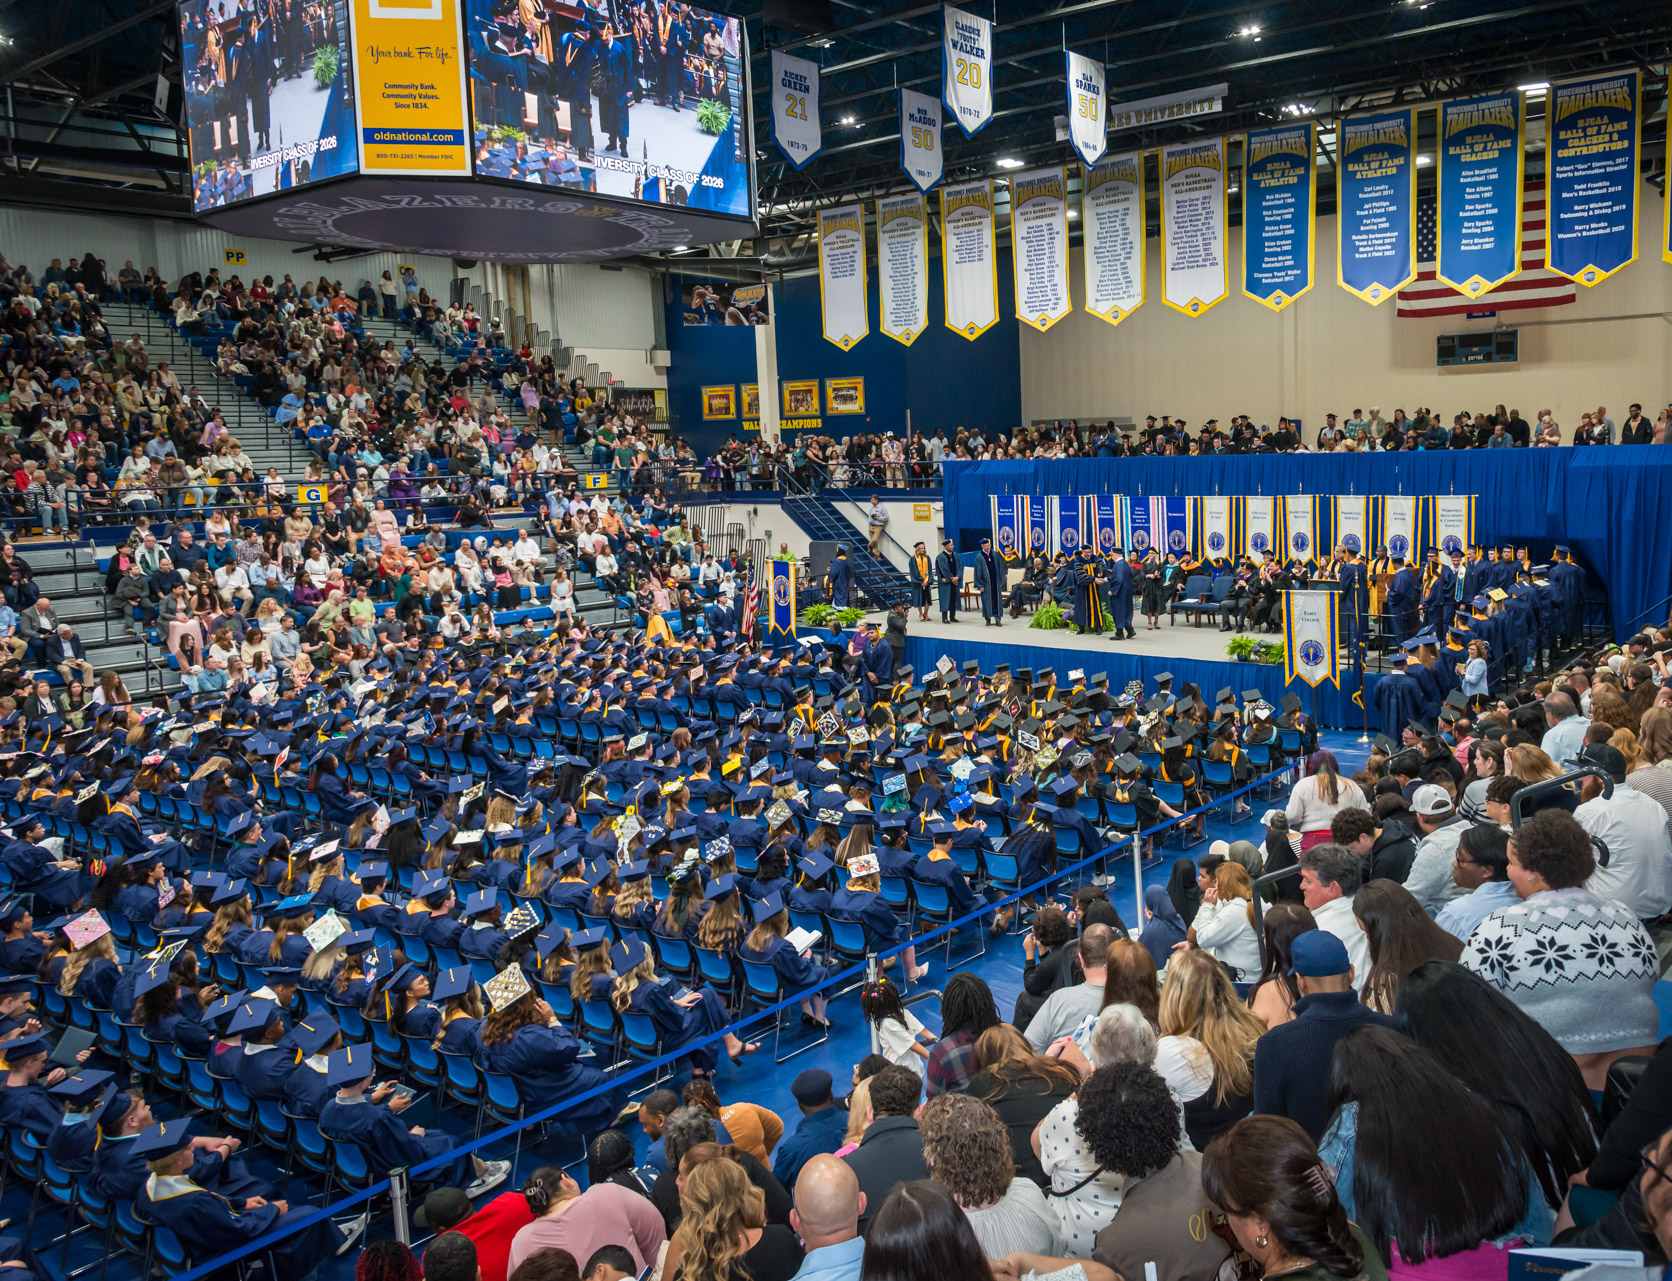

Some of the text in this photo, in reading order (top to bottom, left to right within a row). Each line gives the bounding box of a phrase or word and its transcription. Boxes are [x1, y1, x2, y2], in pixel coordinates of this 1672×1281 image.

[367, 45, 392, 64] Your
[416, 46, 433, 60] For
[951, 39, 985, 59] WALKER
[956, 58, 981, 89] 20
[781, 78, 810, 94] GREEN
[1075, 79, 1100, 95] SPARKS
[1557, 79, 1628, 97] VINCENNES UNIVERSITY
[382, 92, 417, 100] Community
[785, 93, 808, 121] 21
[1078, 95, 1098, 121] 50
[1554, 86, 1632, 123] TRAILBLAZERS
[1446, 105, 1515, 137] TRAILBLAZERS
[374, 131, 454, 142] oldnational.com
[912, 126, 934, 151] 50
[1559, 121, 1628, 140] HALL OF FAME
[1448, 139, 1512, 155] HALL OF FAME
[1567, 132, 1619, 148] COACHES &
[283, 145, 307, 161] CLASS
[308, 141, 319, 153] OF
[319, 136, 337, 151] 2026
[1557, 140, 1629, 158] CONTRIBUTORS
[1348, 156, 1405, 171] HALL OF FAME
[649, 166, 683, 182] CLASS
[685, 173, 699, 184] OF
[701, 175, 724, 189] 2026
[1460, 175, 1486, 183] Basketball
[1579, 188, 1607, 196] Basketball
[1560, 211, 1588, 219] Swimming
[1594, 207, 1612, 215] Diving
[1582, 228, 1610, 236] Basketball
[226, 251, 245, 262] PP
[592, 476, 601, 486] F
[306, 488, 321, 501] G
